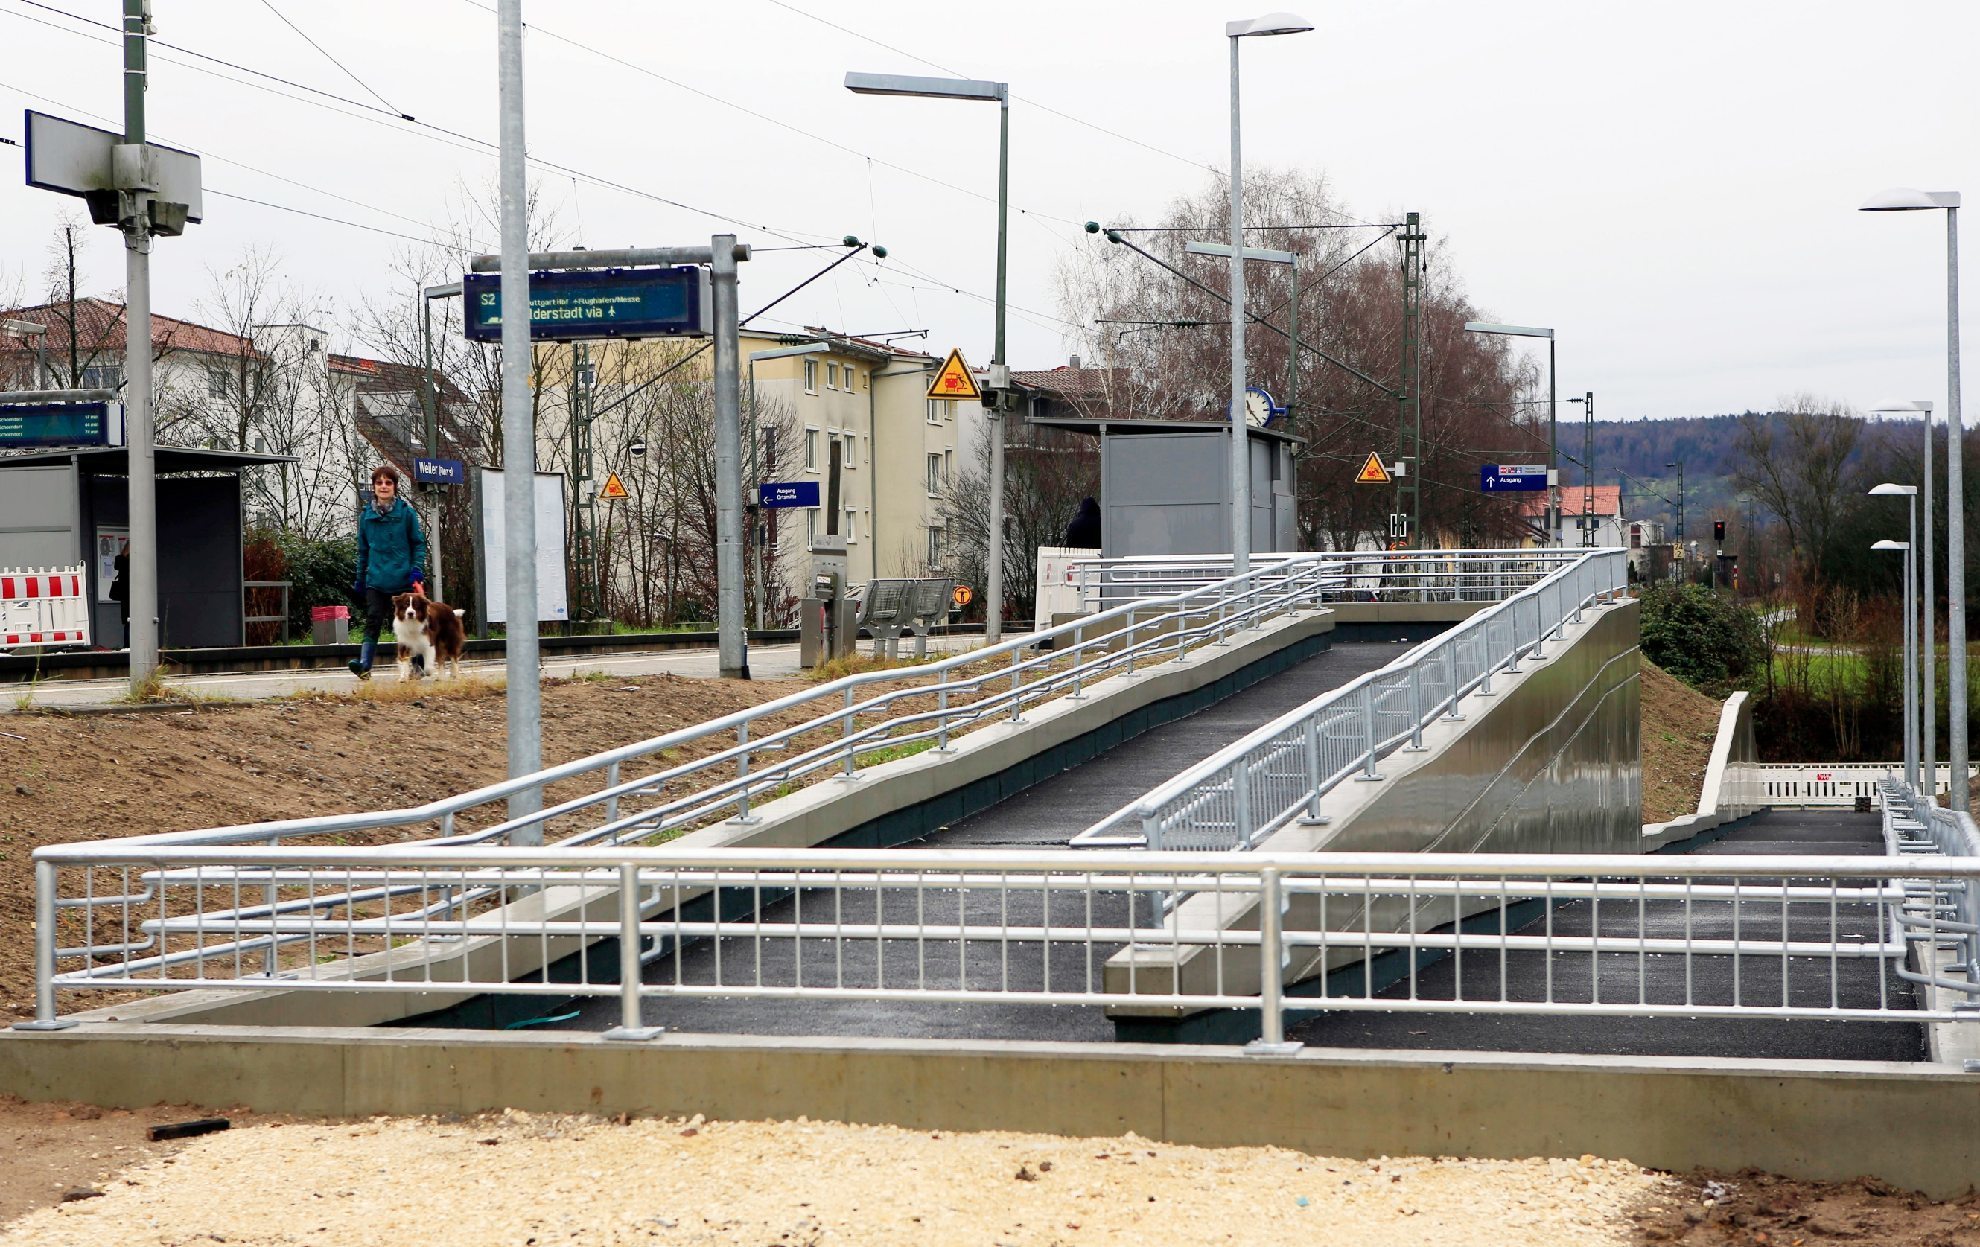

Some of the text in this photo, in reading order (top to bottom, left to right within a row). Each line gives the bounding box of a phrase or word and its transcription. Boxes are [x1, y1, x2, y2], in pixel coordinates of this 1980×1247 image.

[481, 293, 496, 305] S2
[529, 299, 556, 307] uttgart
[529, 306, 602, 320] lderstadt via
[418, 461, 438, 475] Weiler
[1677, 550, 1682, 558] 2
